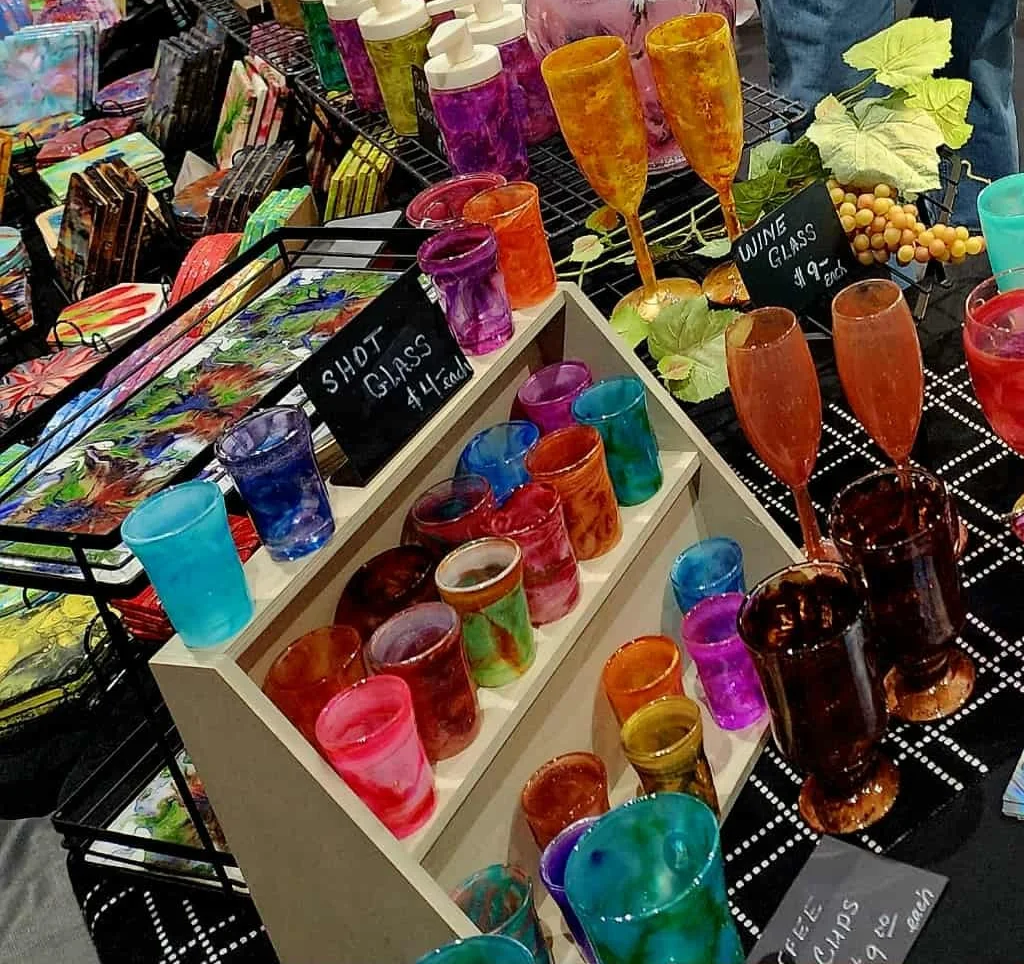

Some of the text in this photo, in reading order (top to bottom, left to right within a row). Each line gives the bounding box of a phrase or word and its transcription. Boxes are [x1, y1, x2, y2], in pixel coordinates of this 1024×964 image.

[738, 212, 787, 263] WINE
[768, 223, 817, 268] GLASS
[322, 325, 383, 394] SHOT
[363, 334, 432, 398] GLASS
